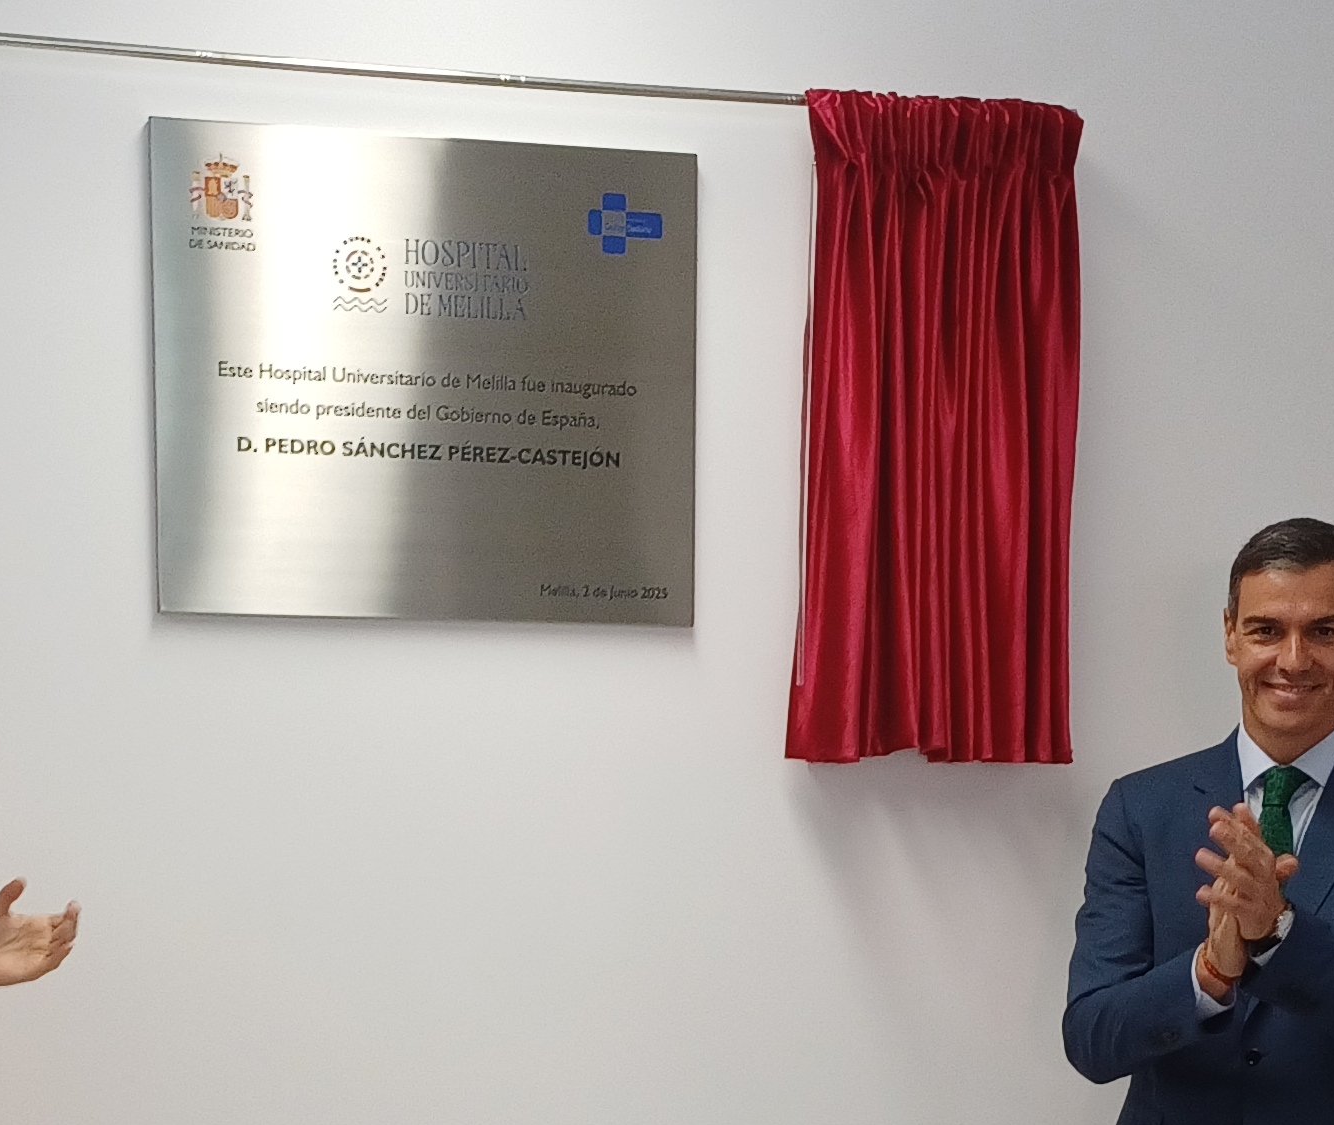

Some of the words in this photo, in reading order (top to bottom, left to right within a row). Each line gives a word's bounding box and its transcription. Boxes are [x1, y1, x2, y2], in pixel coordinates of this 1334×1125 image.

[188, 239, 203, 249] DE
[191, 226, 253, 238] MINISTERIO
[404, 238, 527, 271] HOSPITAL
[404, 270, 529, 294] UNIVERSITARIO
[405, 293, 432, 316] DE
[438, 294, 526, 320] MELILLA
[218, 361, 253, 379] Este
[259, 363, 327, 384] Hospital
[332, 367, 436, 387] Universitario
[441, 373, 461, 389] de
[466, 374, 516, 391] Melilla
[521, 376, 546, 393] fue
[551, 380, 637, 398] inaugurado
[256, 398, 311, 415] siendo
[316, 401, 402, 420] presidente
[407, 403, 431, 421] del
[435, 405, 512, 425] Gobierno
[517, 409, 536, 425] de
[542, 410, 599, 430] España,
[237, 436, 258, 453] D.
[265, 438, 336, 456] PEDRO
[342, 437, 442, 461] SÁNCHEZ
[448, 440, 620, 470] PÉREZ-CASTEJÓN
